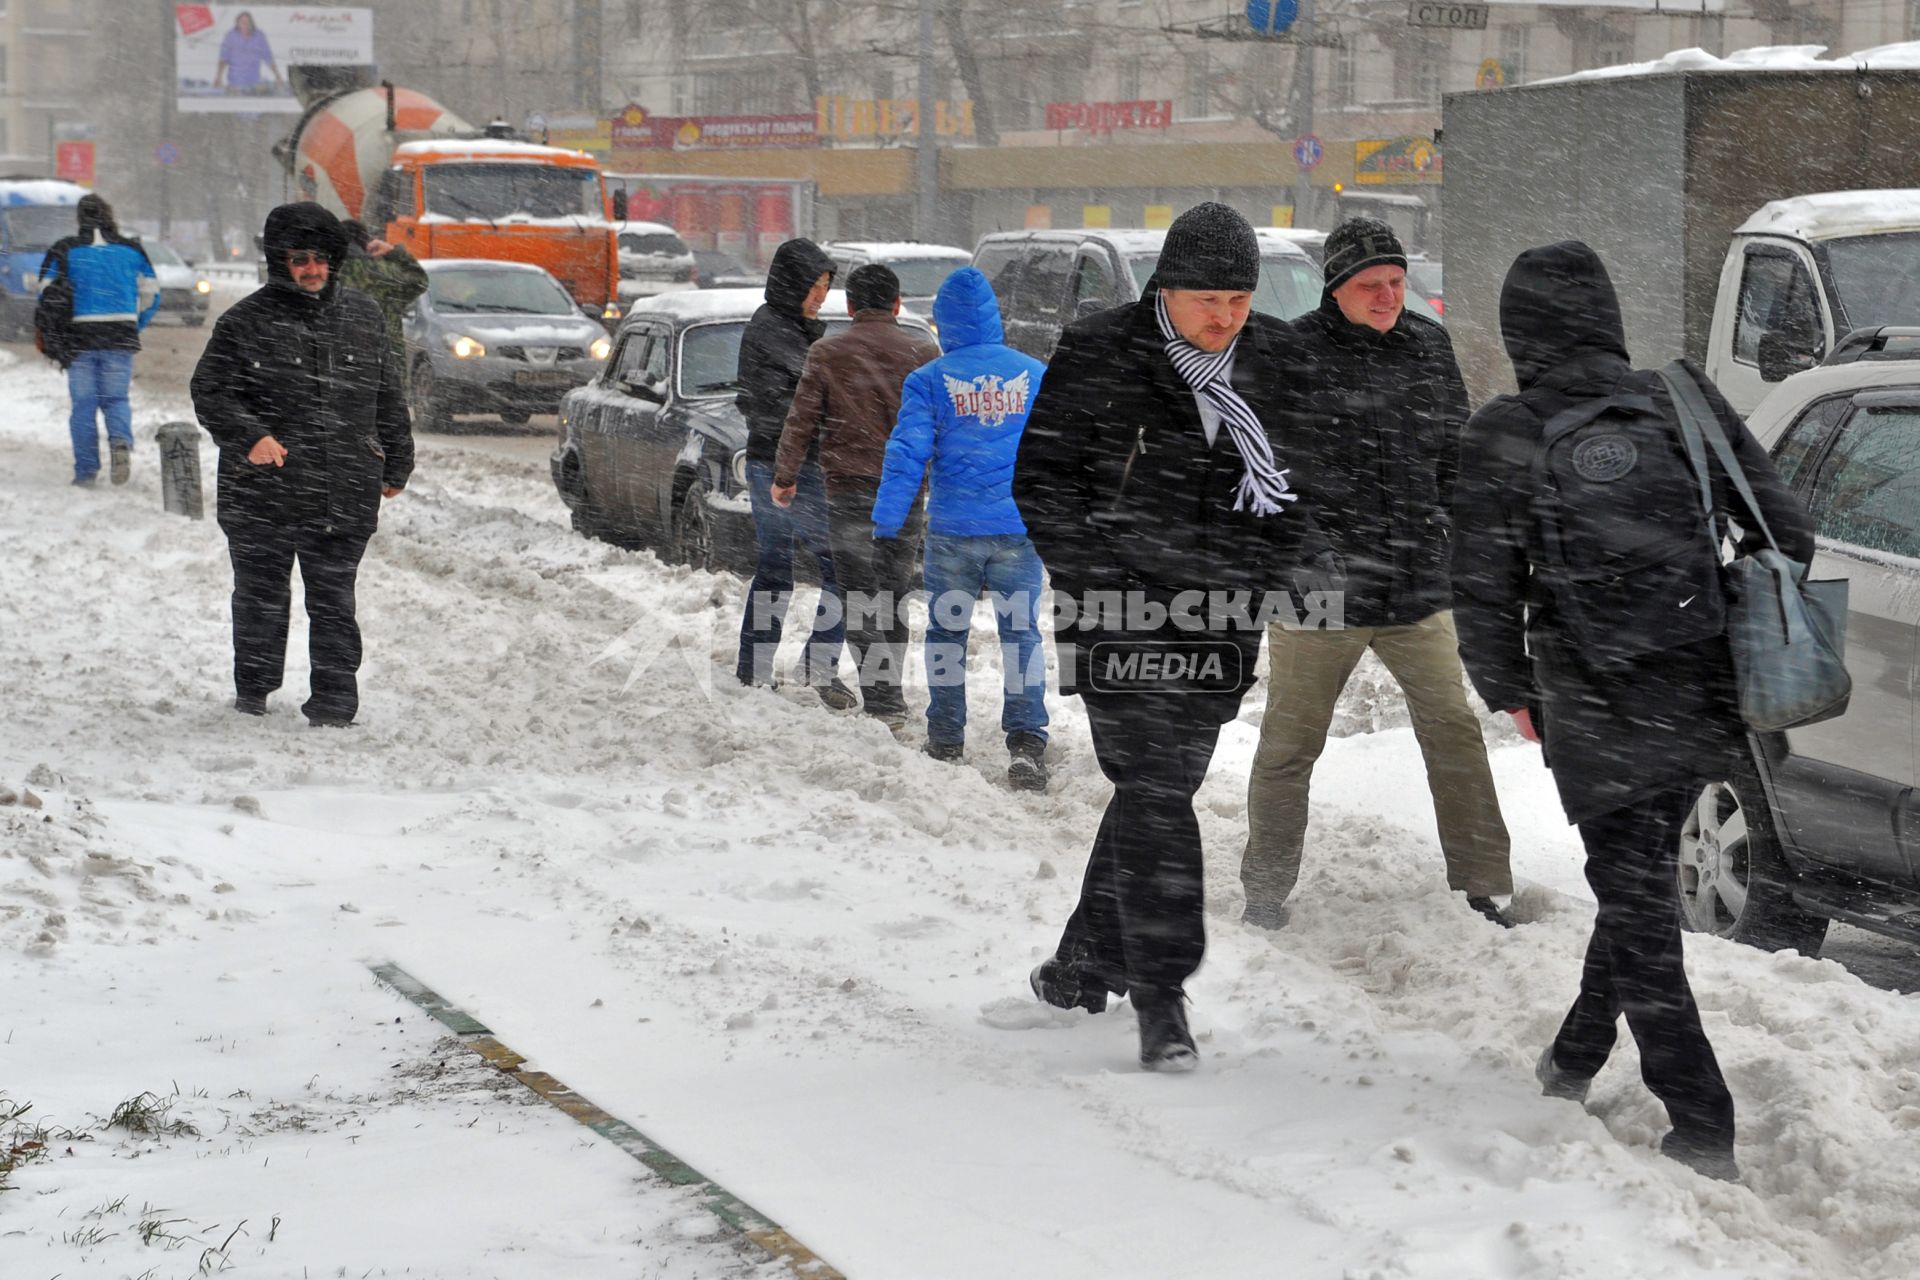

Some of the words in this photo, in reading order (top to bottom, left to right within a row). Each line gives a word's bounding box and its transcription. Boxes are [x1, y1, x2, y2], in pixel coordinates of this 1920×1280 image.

[1419, 6, 1478, 25] СТОП
[815, 96, 975, 140] ЦВЕТЫ
[1045, 99, 1172, 136] ПРОДУКТЫ
[955, 390, 1025, 416] RUSSIA
